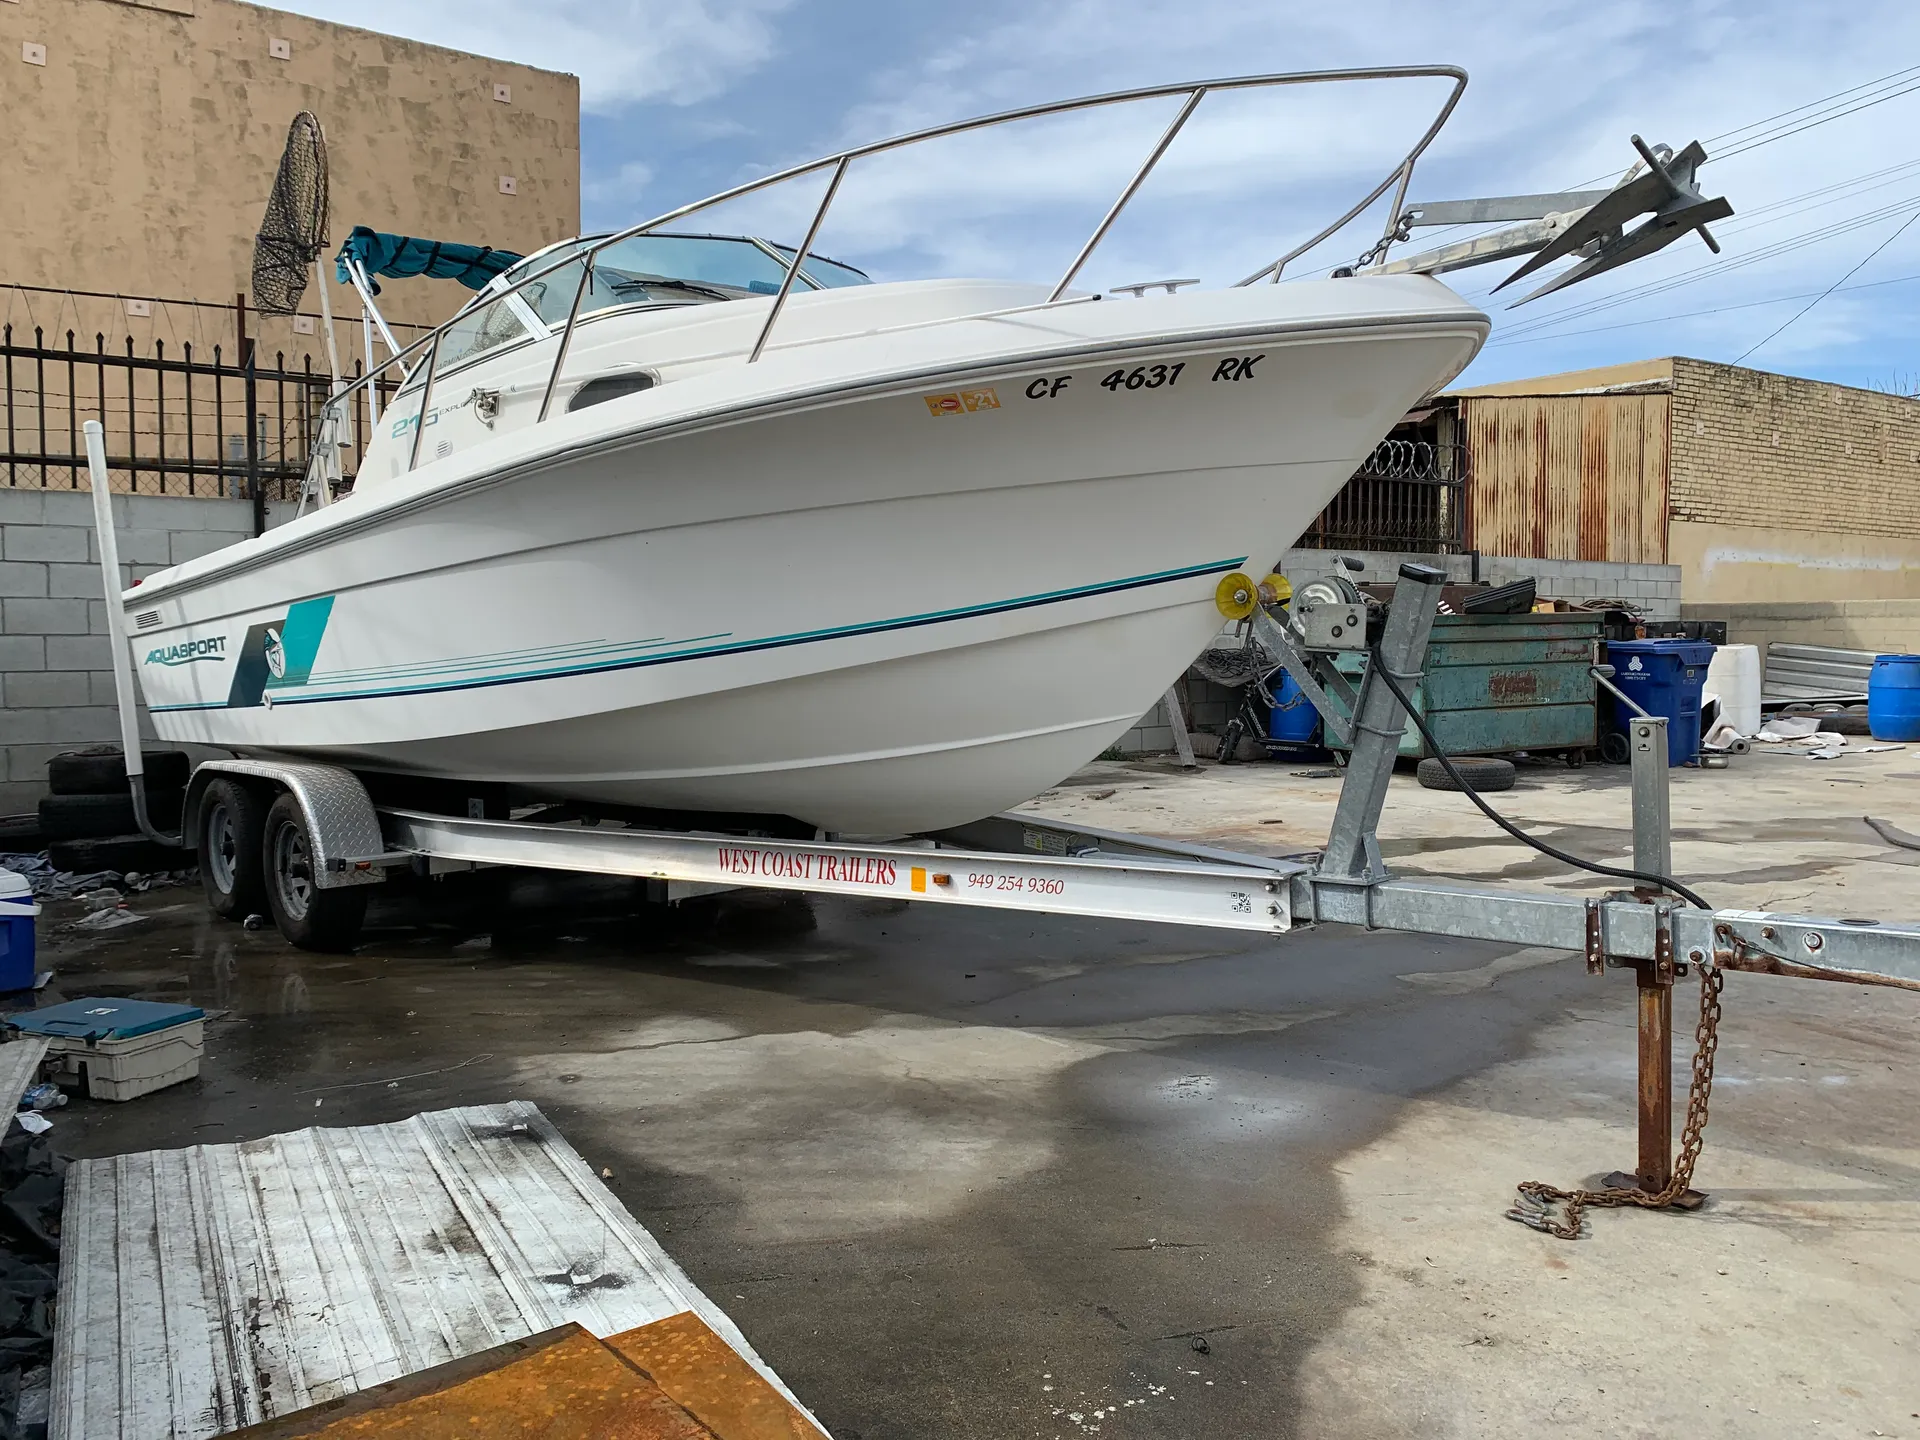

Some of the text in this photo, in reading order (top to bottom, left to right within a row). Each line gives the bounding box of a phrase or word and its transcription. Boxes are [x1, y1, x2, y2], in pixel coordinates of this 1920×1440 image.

[1024, 354, 1266, 400] CF 4631 RK
[391, 407, 439, 440] 215
[144, 635, 227, 666] AQUASPORT
[718, 847, 897, 886] WEST COAST TRAILERS
[967, 872, 1065, 895] 949 254 9360
